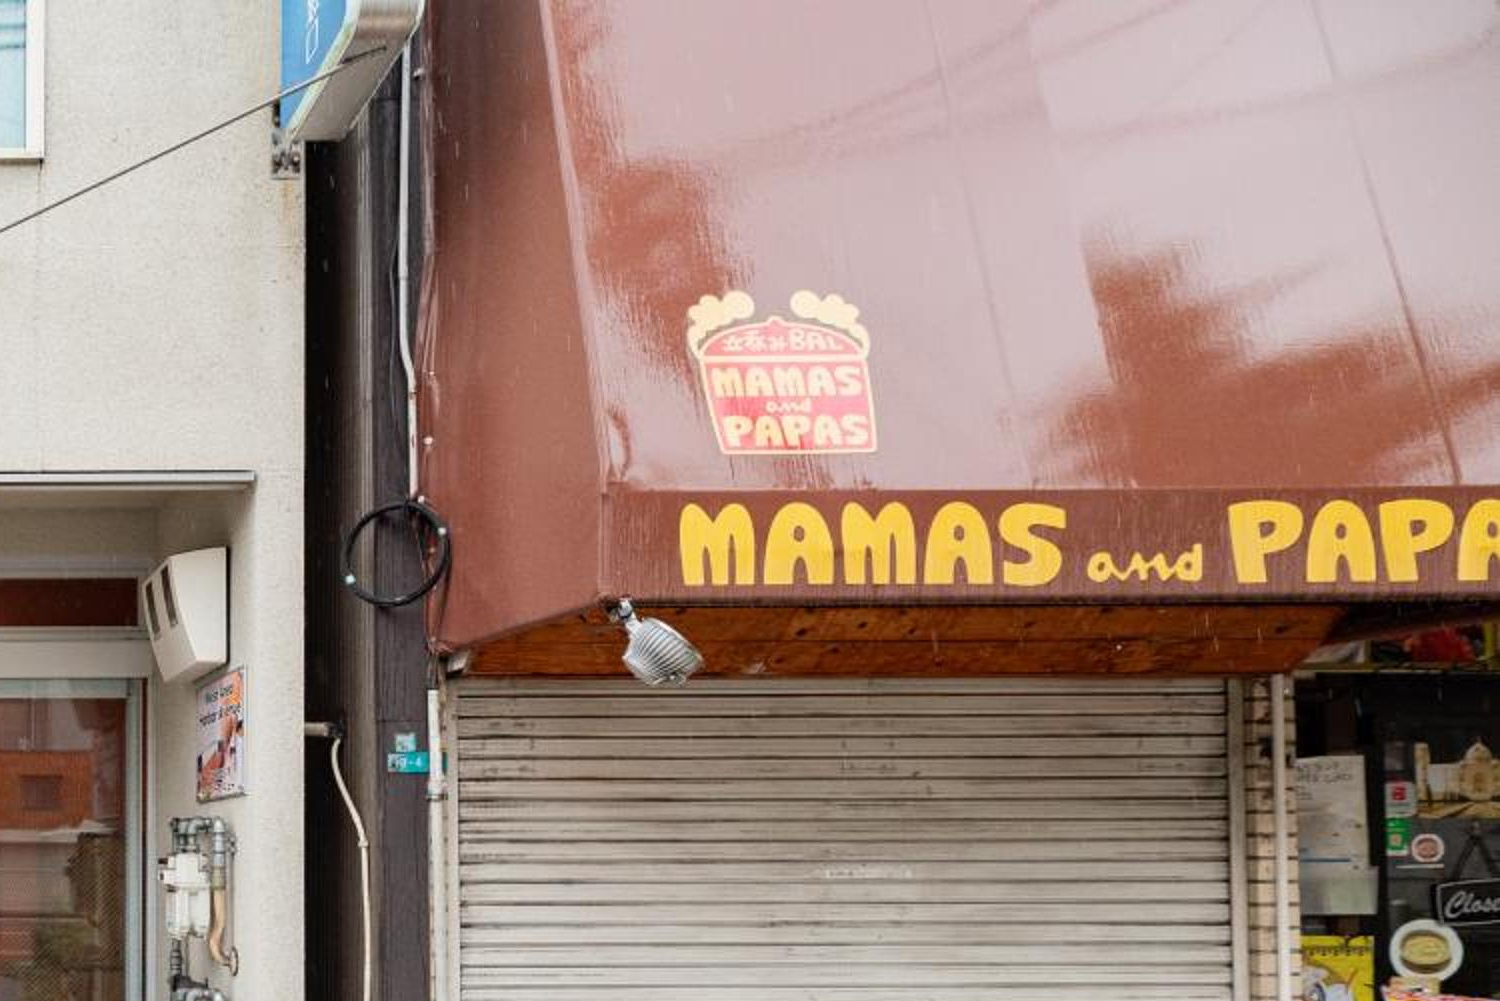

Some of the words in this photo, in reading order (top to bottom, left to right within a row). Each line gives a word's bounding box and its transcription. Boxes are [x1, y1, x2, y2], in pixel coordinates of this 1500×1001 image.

[711, 366, 862, 397] MAMAS
[765, 398, 812, 414] and
[723, 414, 869, 447] PAPAS
[679, 501, 1066, 586] MAMAS
[1087, 543, 1203, 583] and
